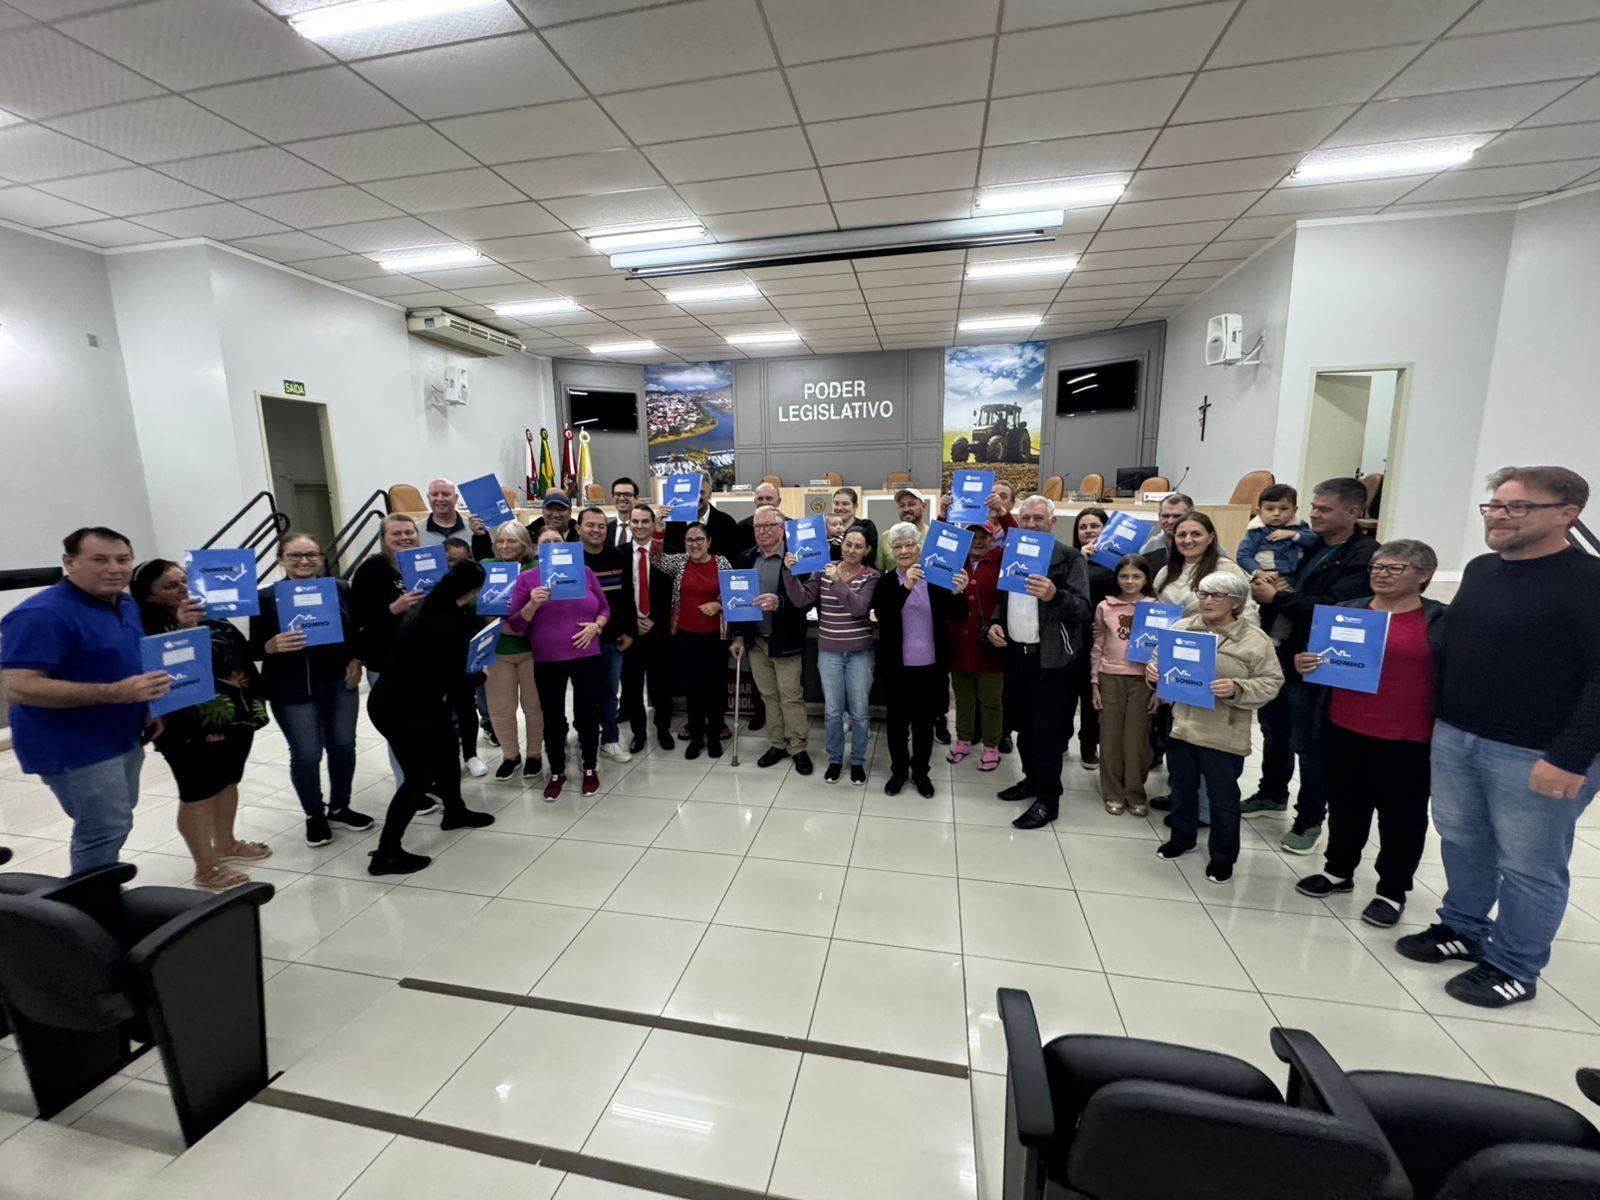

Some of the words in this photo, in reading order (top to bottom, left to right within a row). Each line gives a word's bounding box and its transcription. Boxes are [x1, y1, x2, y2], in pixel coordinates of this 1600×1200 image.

[803, 380, 866, 399] PODER
[777, 400, 894, 422] LEGISLATIVO
[1329, 658, 1366, 669] SONHO
[1175, 676, 1204, 687] SONHO
